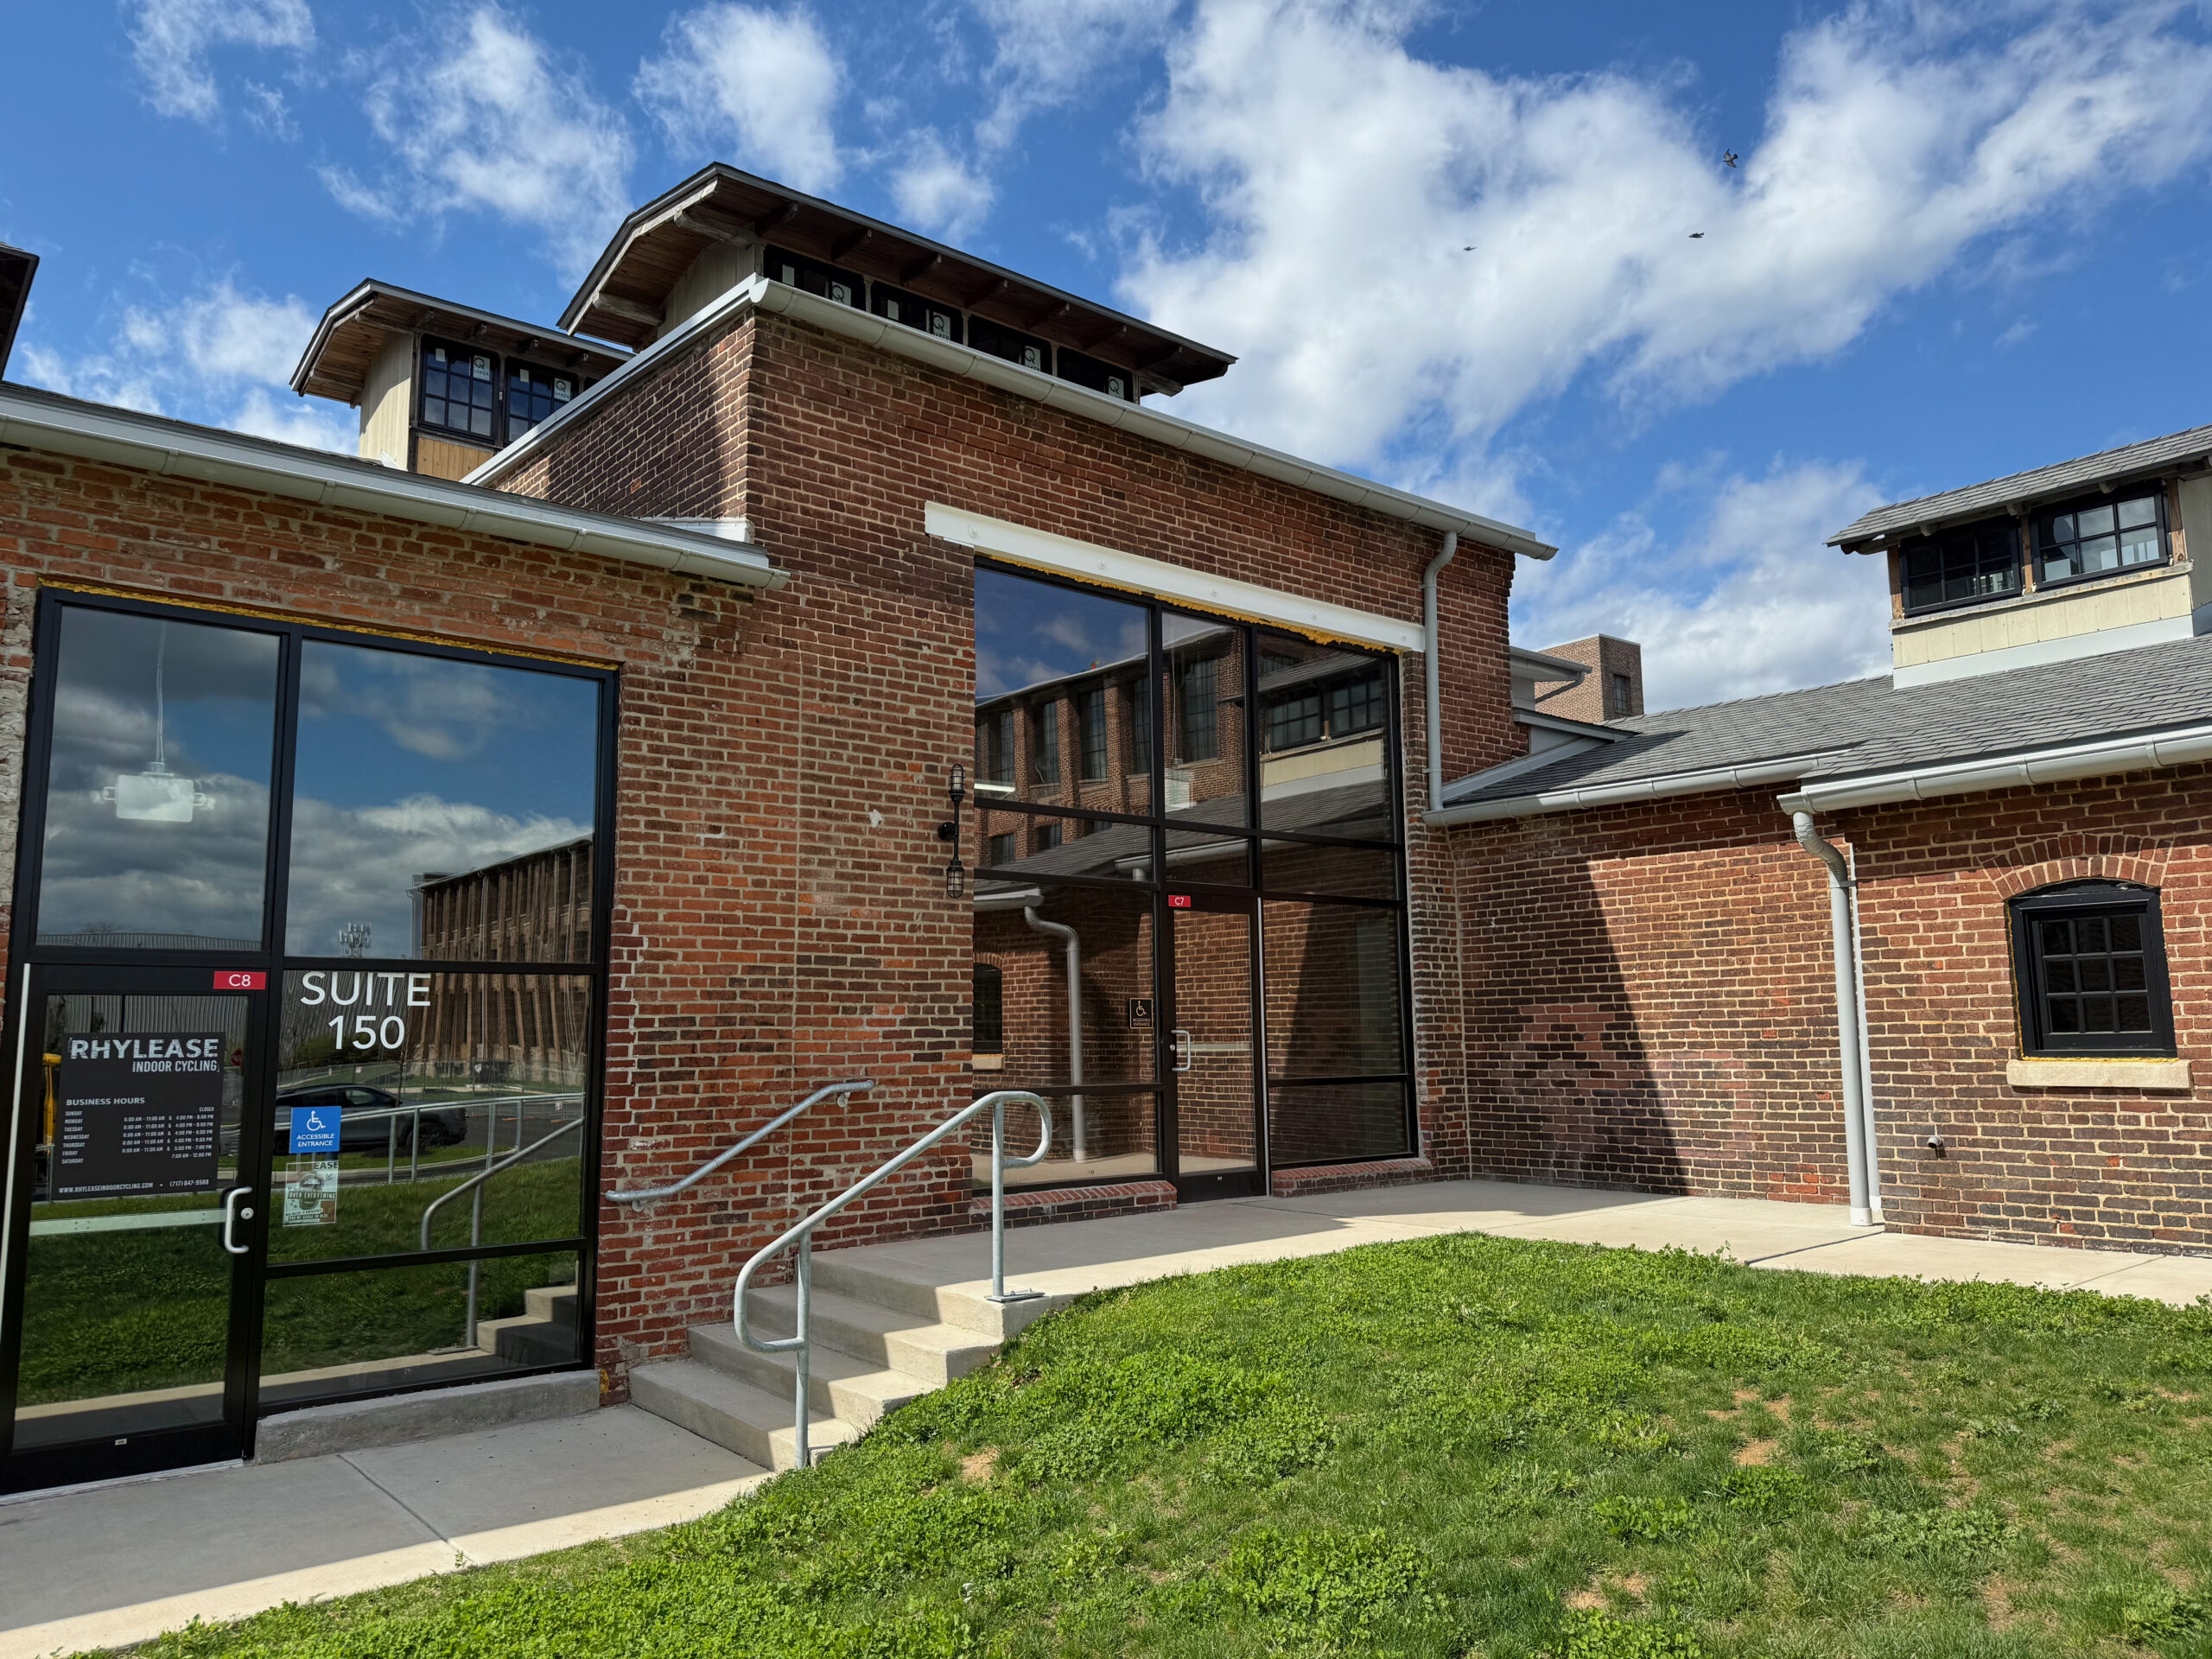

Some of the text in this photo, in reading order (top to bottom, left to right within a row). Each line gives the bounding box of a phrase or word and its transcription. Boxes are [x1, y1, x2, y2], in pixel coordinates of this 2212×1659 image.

[1175, 897, 1185, 906] C7
[229, 974, 251, 987] C8
[300, 971, 431, 1006] SUITE
[328, 1015, 405, 1050] 150
[70, 1039, 219, 1059] RHYLEASE
[175, 1060, 217, 1072] CYCLING
